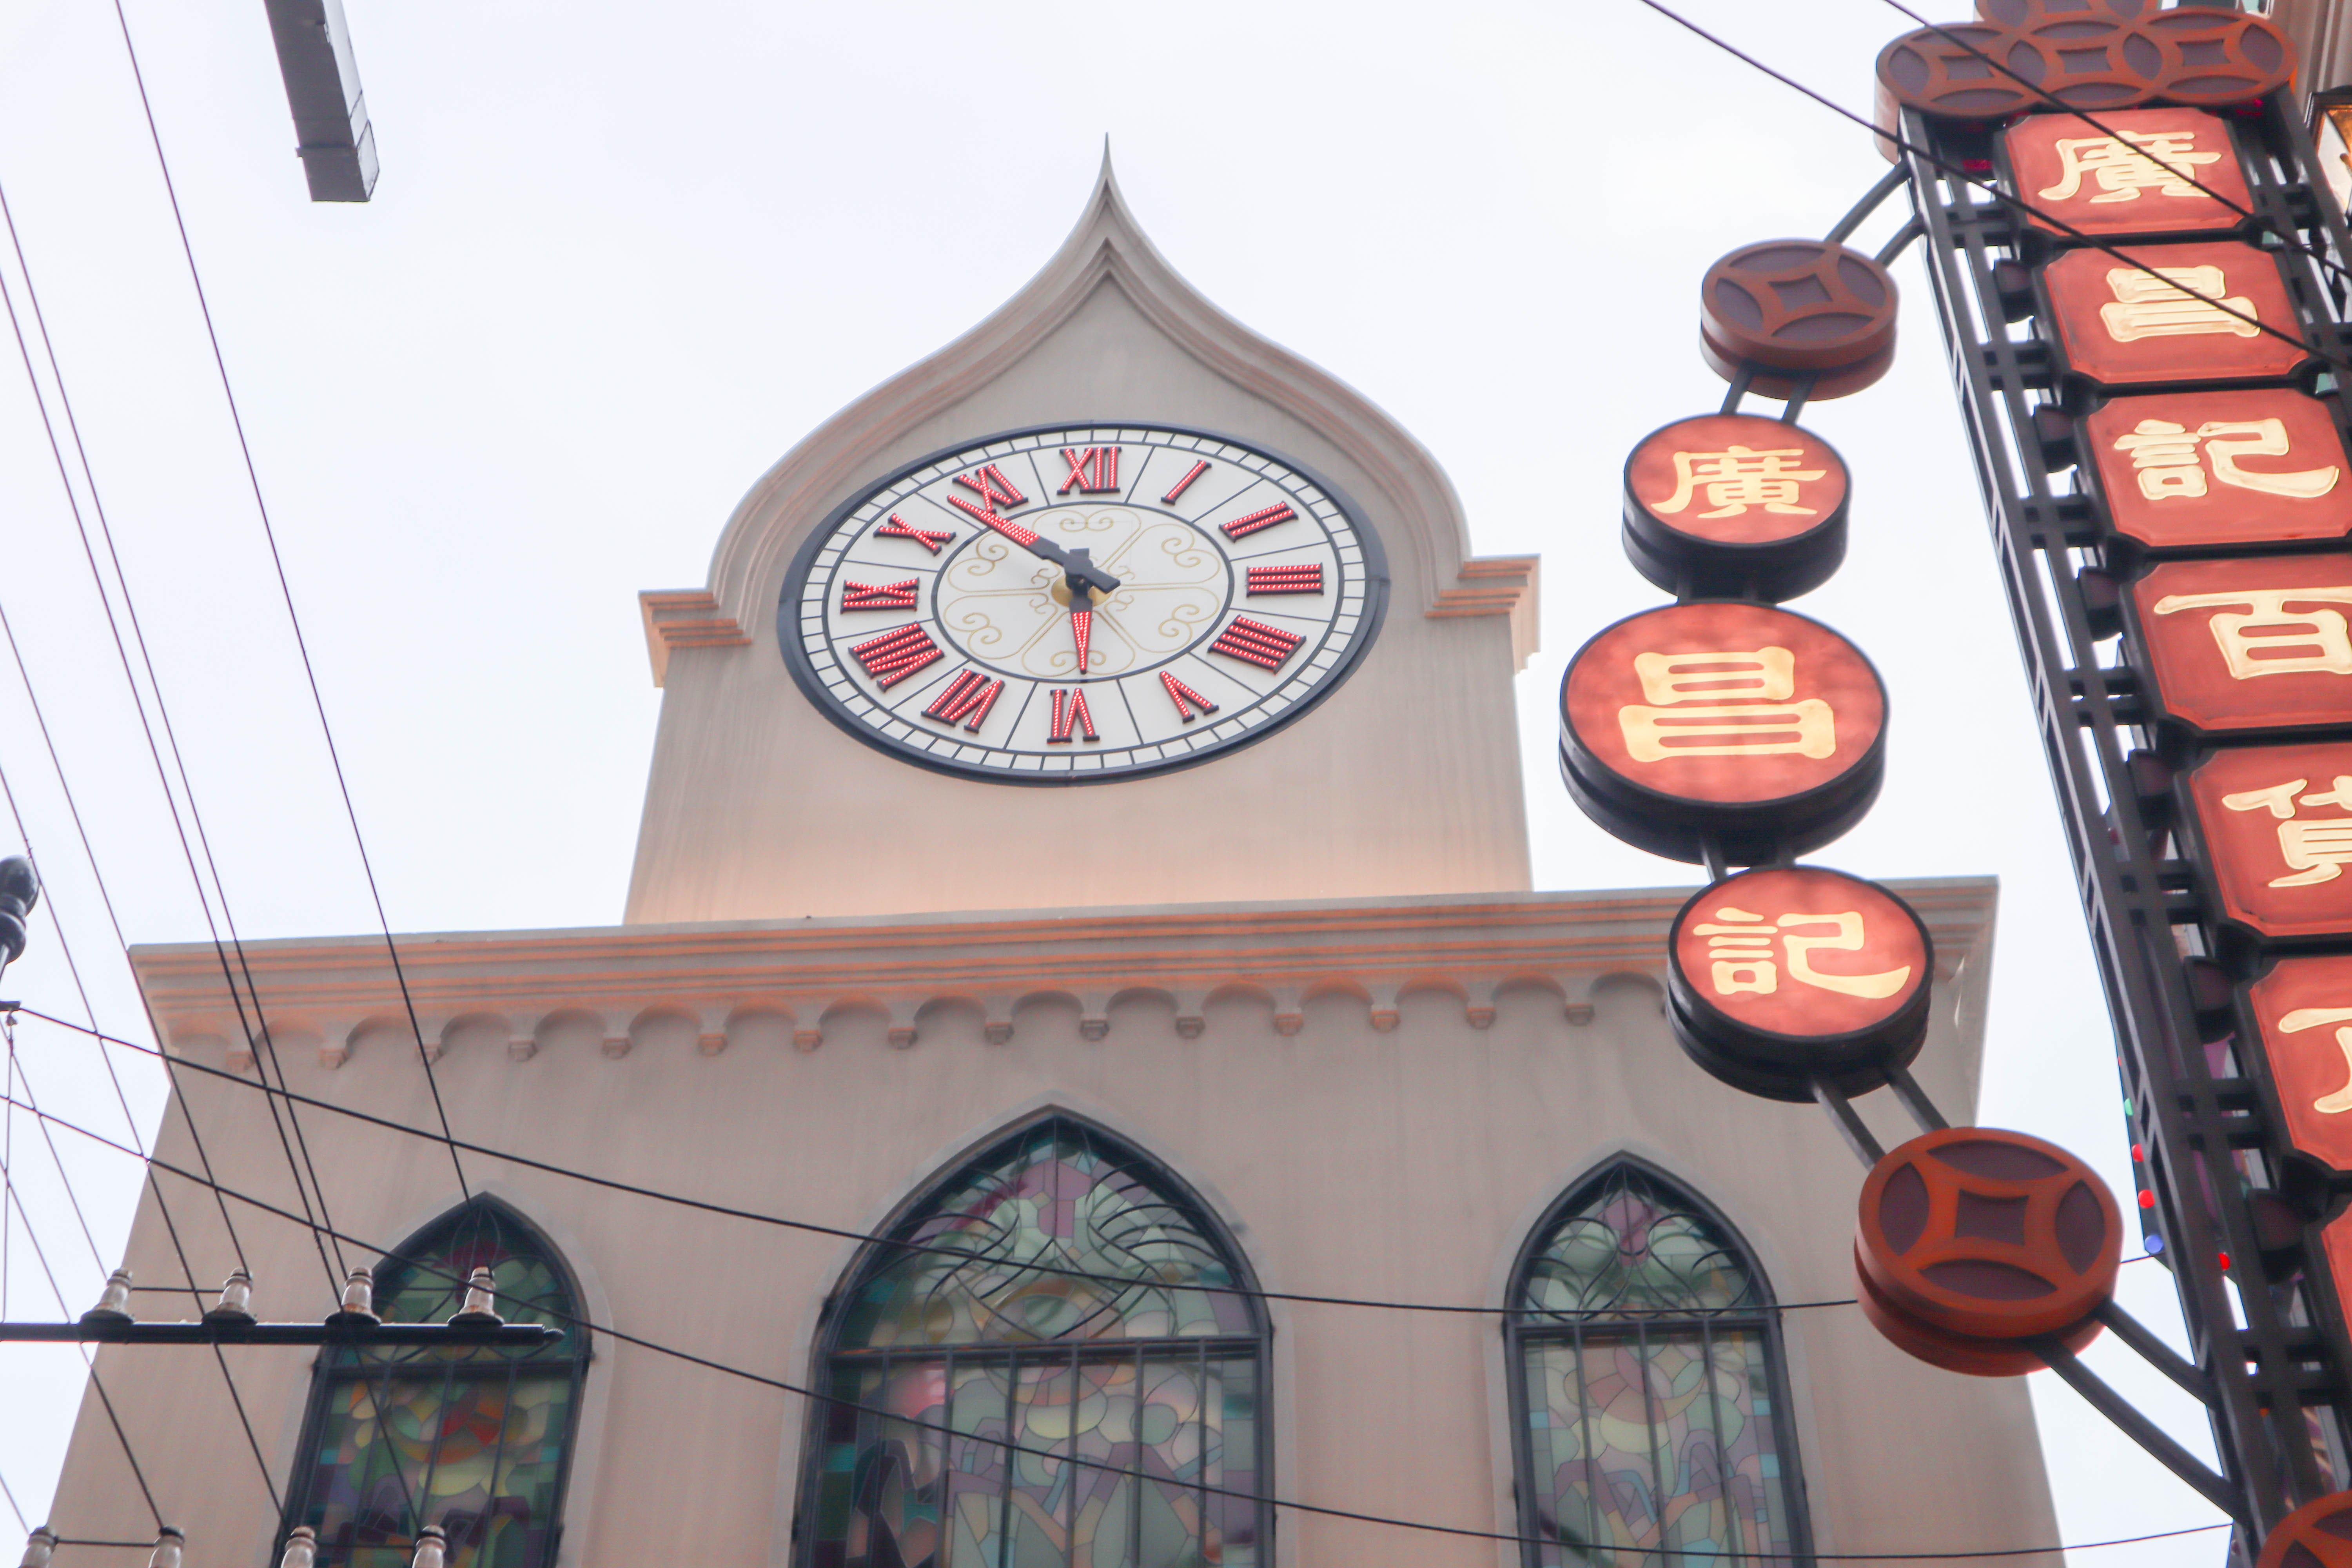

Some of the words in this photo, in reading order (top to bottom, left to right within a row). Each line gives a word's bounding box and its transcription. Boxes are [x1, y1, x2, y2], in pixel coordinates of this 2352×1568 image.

[953, 463, 1029, 514] XI
[1057, 446, 1121, 495] XII
[1161, 459, 1212, 505] I
[873, 512, 956, 556] X
[1219, 500, 1298, 541] II
[840, 577, 920, 614] IX
[1246, 562, 1324, 597] III
[848, 621, 945, 692] VIII
[1207, 614, 1307, 674] IIII
[921, 668, 1005, 733] VII
[1047, 688, 1100, 744] VI
[1159, 670, 1220, 724] V
[1617, 445, 1911, 998] 廣昌記
